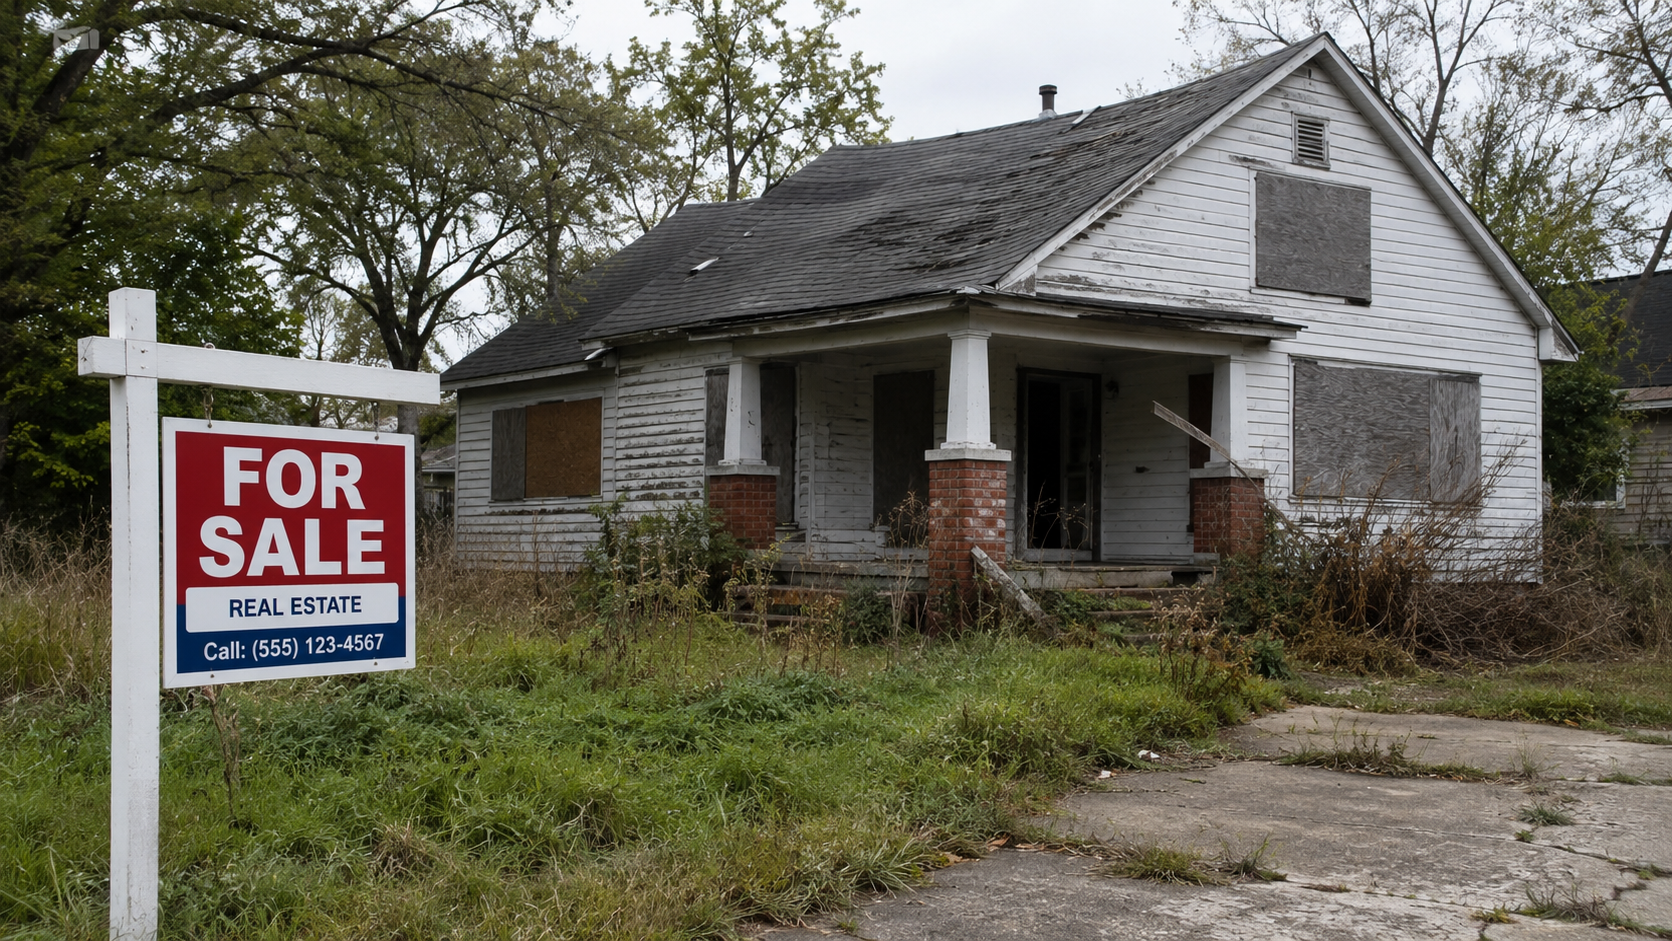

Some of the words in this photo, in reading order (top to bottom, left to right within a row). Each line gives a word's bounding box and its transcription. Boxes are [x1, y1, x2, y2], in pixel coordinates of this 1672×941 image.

[223, 446, 366, 510] FOR
[199, 515, 386, 578] SALE
[229, 598, 284, 618] REAL
[290, 595, 362, 615] ESTATE
[203, 641, 246, 661] Call:
[252, 637, 299, 661] (555)
[305, 633, 384, 655] 123-4567
